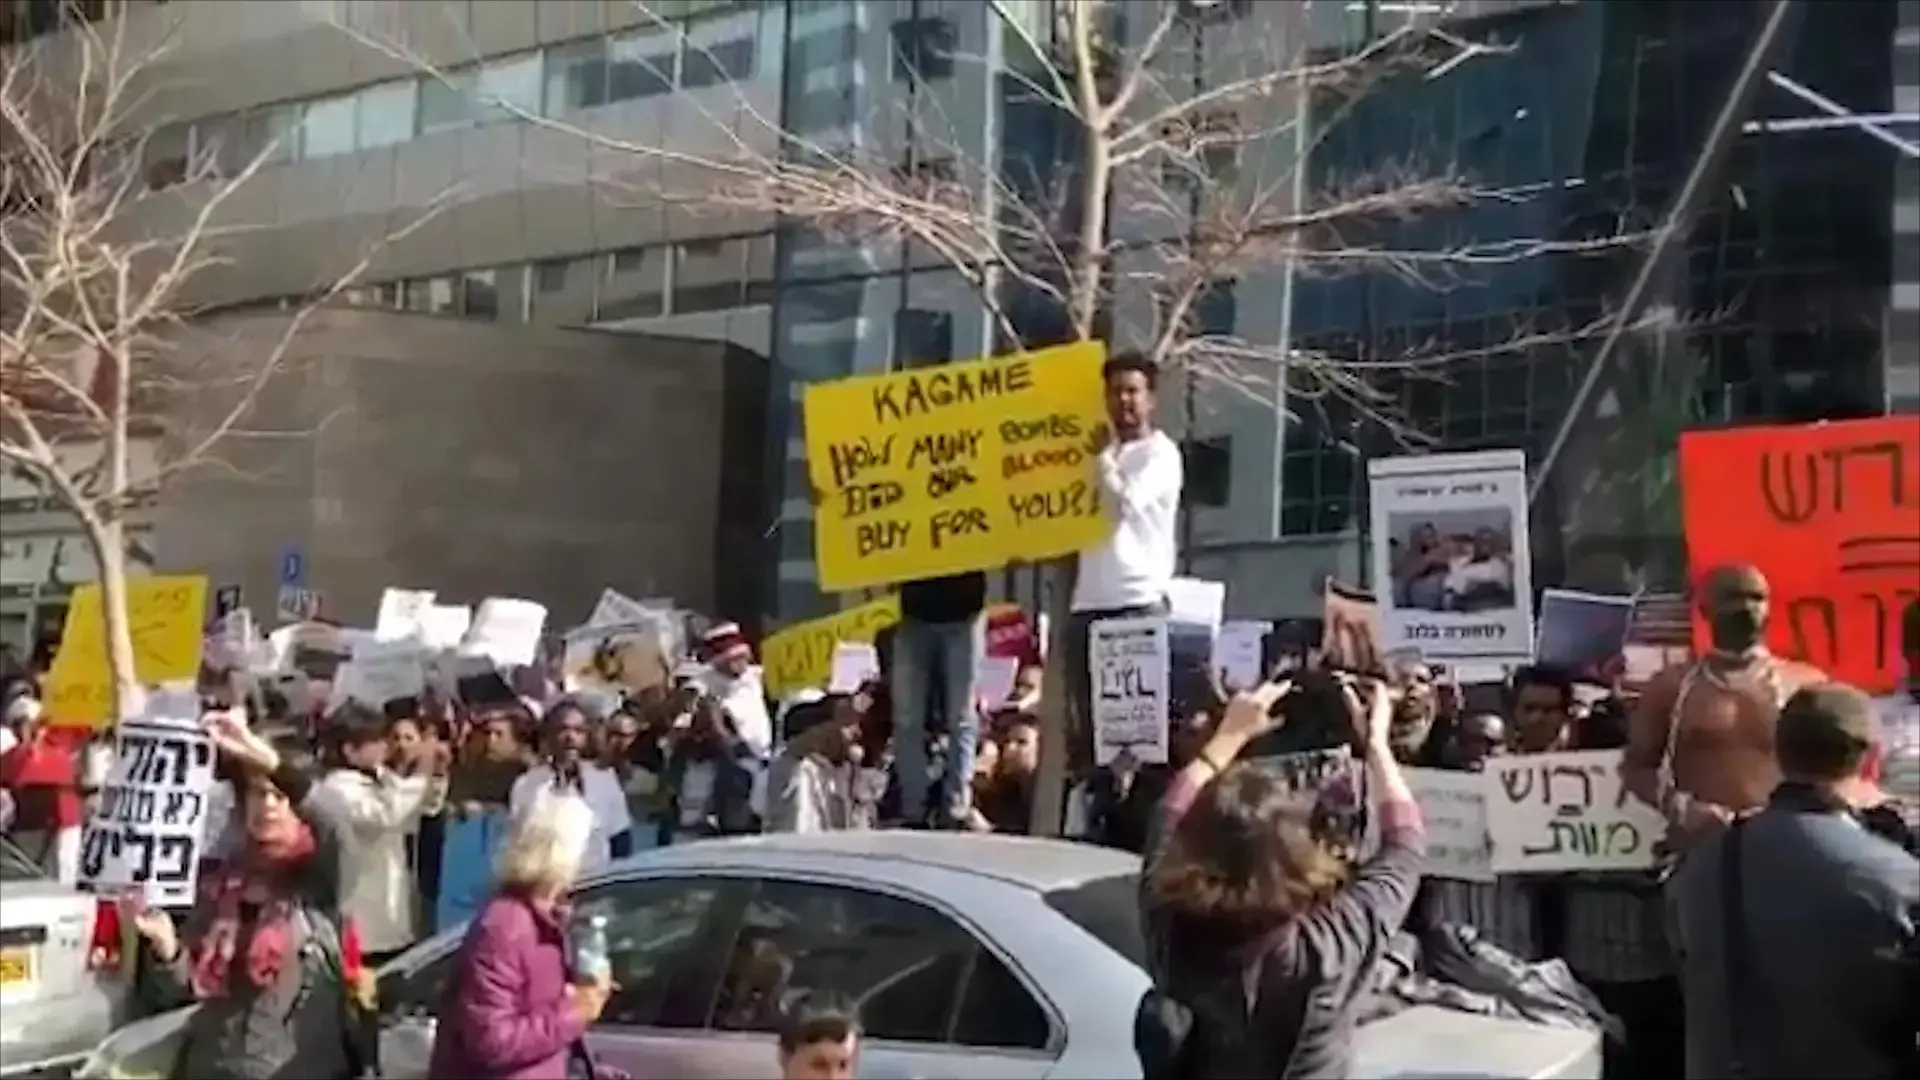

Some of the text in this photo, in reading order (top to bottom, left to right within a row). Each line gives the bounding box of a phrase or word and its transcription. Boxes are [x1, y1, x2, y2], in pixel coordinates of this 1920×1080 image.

[872, 362, 1034, 424] KAGAME
[829, 413, 1082, 487] HOW MANY BOMBS
[1001, 447, 1083, 479] BLOOD
[857, 521, 912, 558] BUY
[929, 507, 990, 550] FOR
[164, 790, 201, 826] לא
[82, 826, 194, 883] פליט
